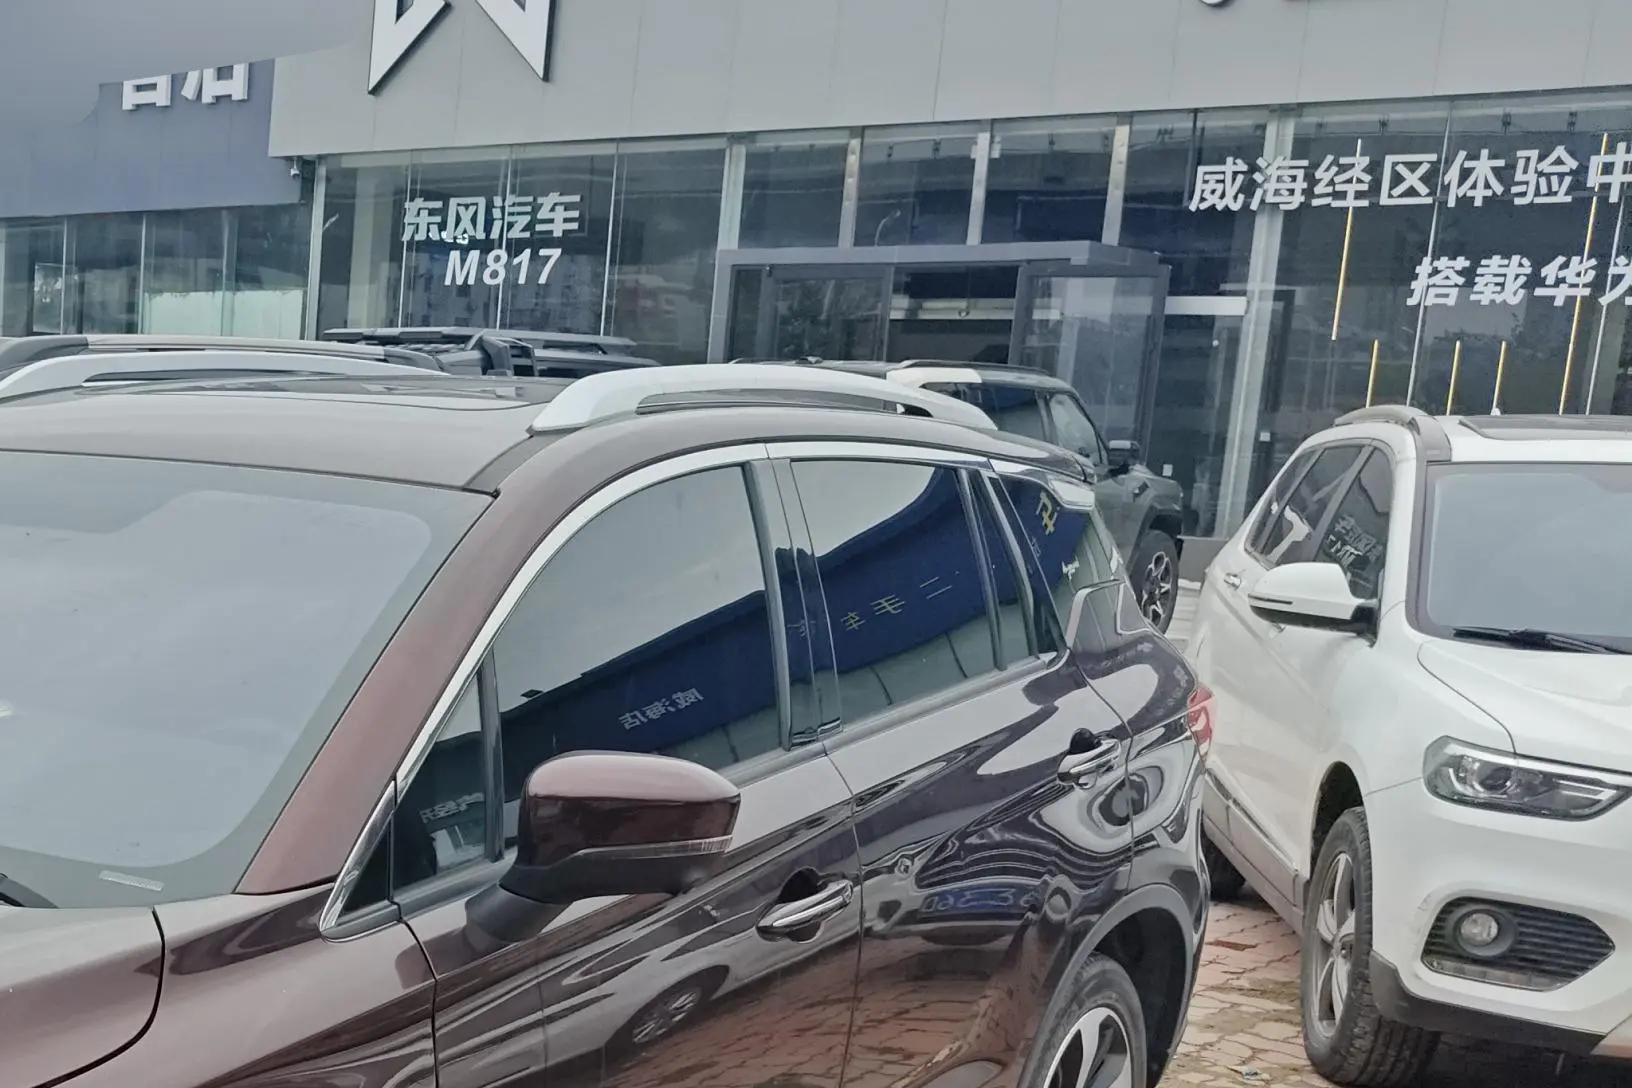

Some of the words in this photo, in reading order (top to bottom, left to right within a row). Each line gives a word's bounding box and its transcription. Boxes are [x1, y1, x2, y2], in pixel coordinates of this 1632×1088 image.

[401, 191, 582, 242] 东风汽车
[444, 247, 562, 287] M817
